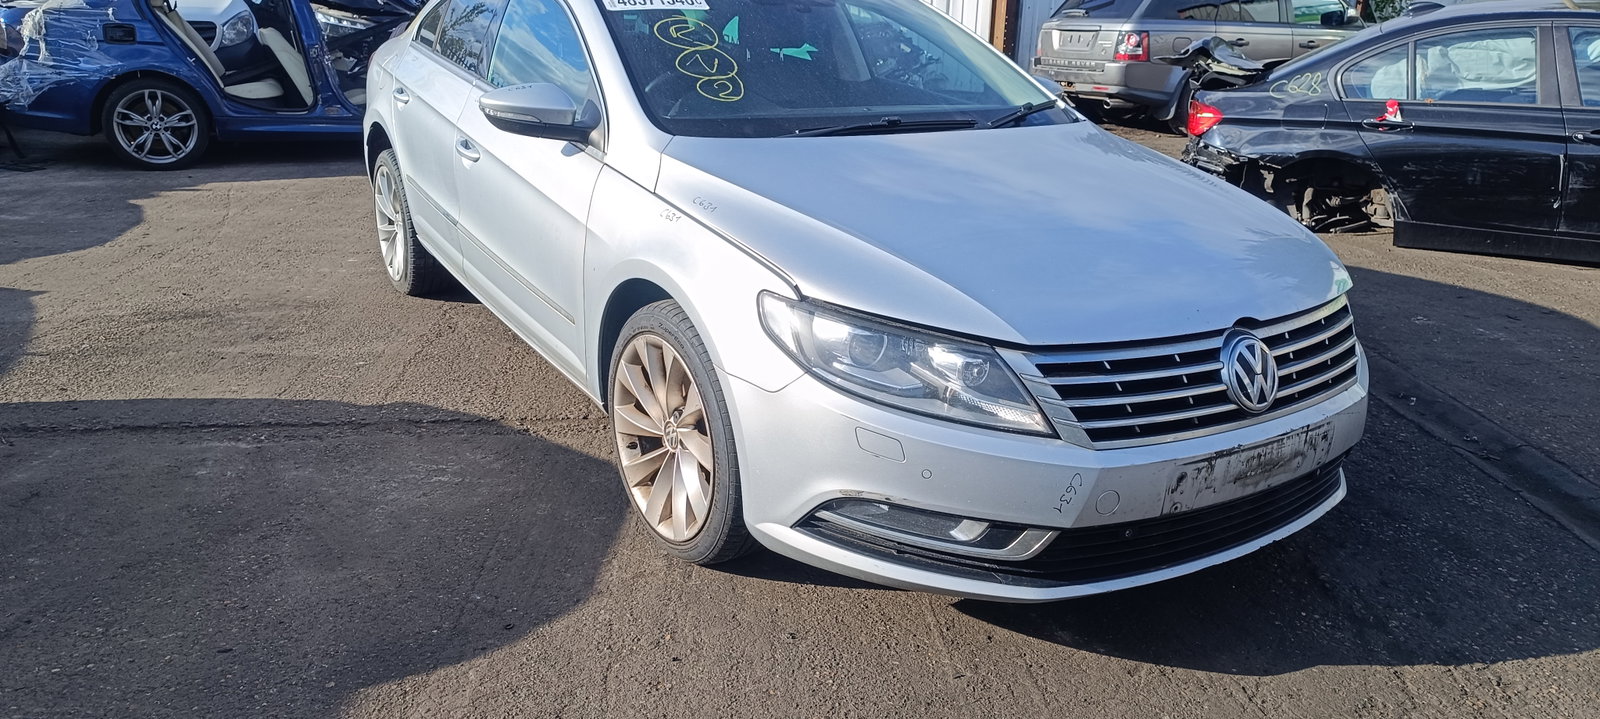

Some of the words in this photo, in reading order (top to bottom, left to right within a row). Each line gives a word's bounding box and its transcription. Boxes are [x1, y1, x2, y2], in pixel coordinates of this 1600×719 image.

[713, 80, 736, 98] 2
[1269, 72, 1321, 98] C628
[692, 196, 717, 213] C631
[1231, 338, 1276, 409] VW
[1053, 472, 1083, 514] C631
